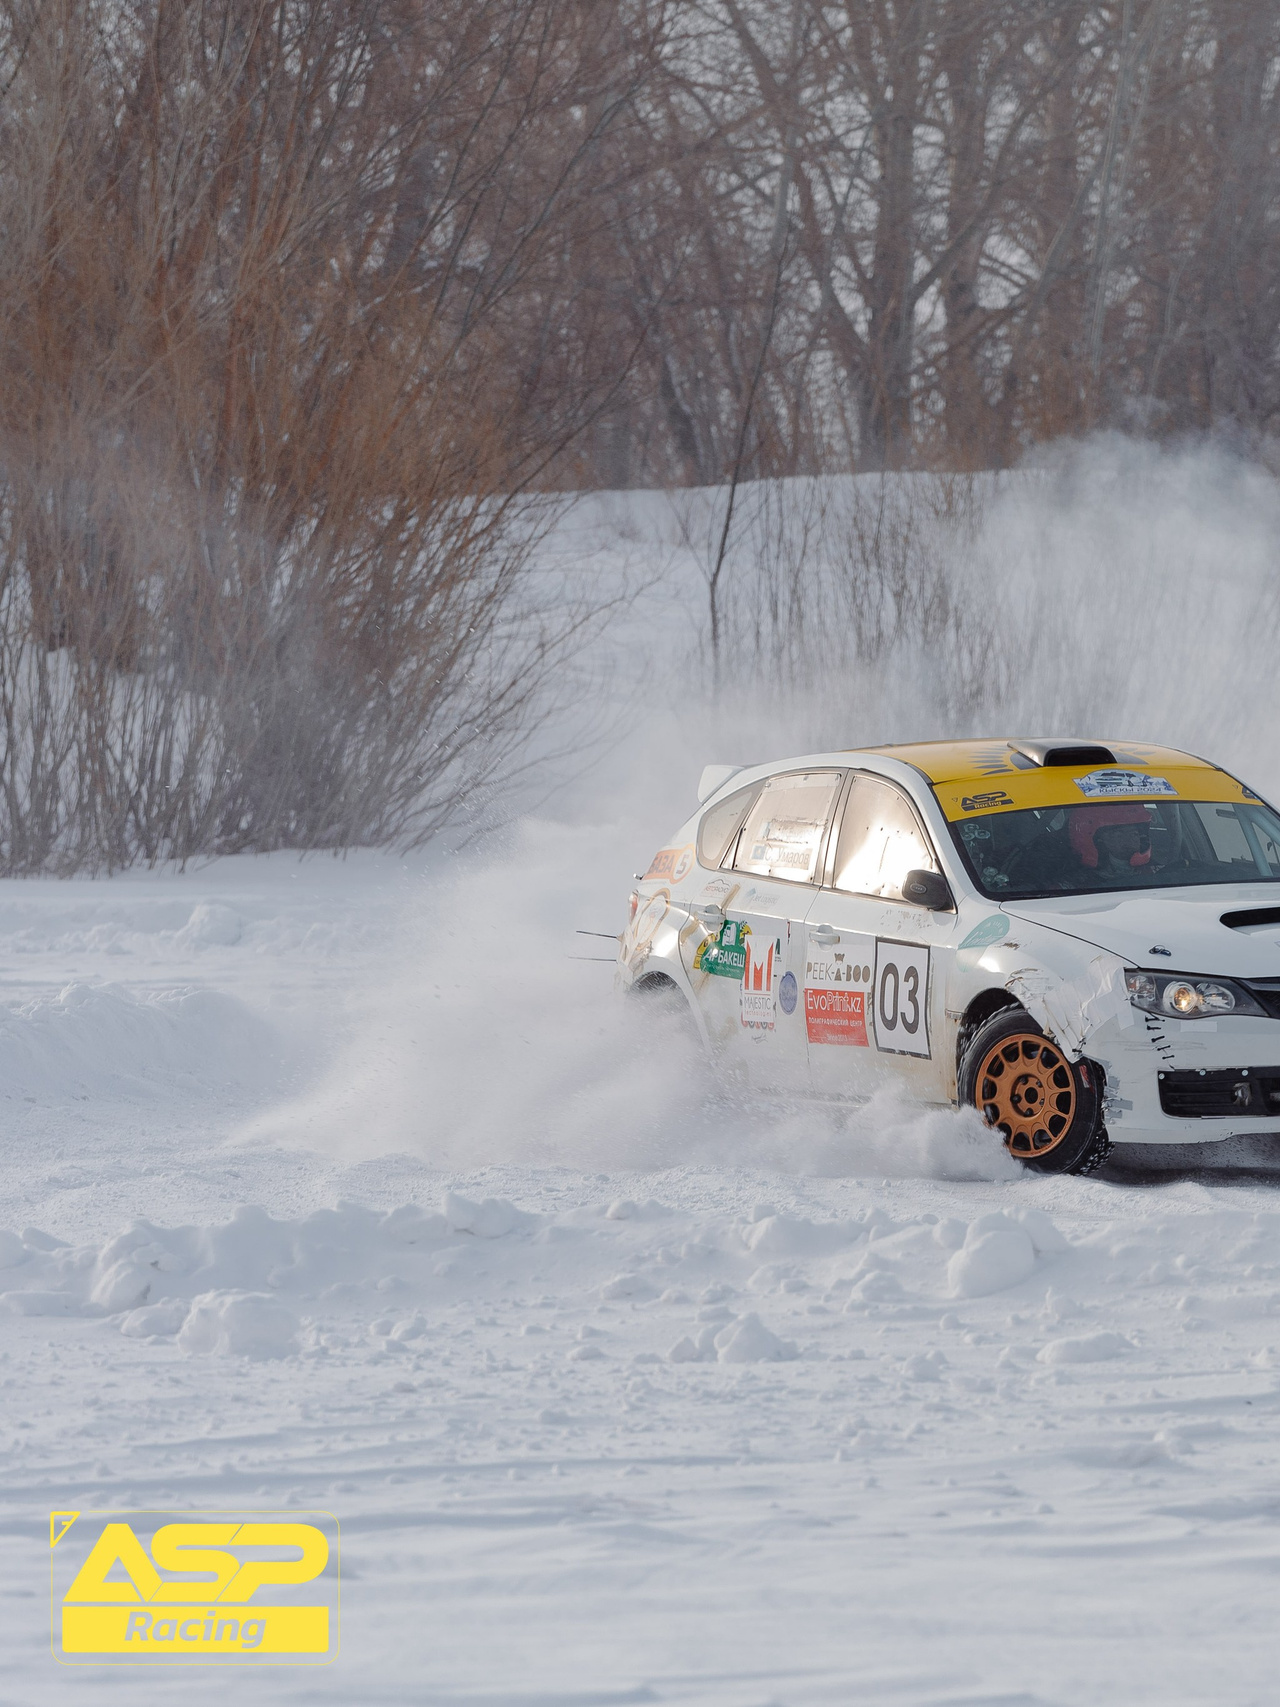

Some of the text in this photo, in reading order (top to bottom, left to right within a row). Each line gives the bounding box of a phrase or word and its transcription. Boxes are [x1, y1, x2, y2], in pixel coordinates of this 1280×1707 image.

[961, 791, 1007, 807] ASP
[974, 801, 1002, 809] Racing
[676, 853, 691, 875] 5
[703, 949, 745, 968] АРБАКЕШ
[806, 962, 870, 983] PEEK-A-BOO
[744, 996, 771, 1011] MAJESTIC
[879, 962, 920, 1034] 03
